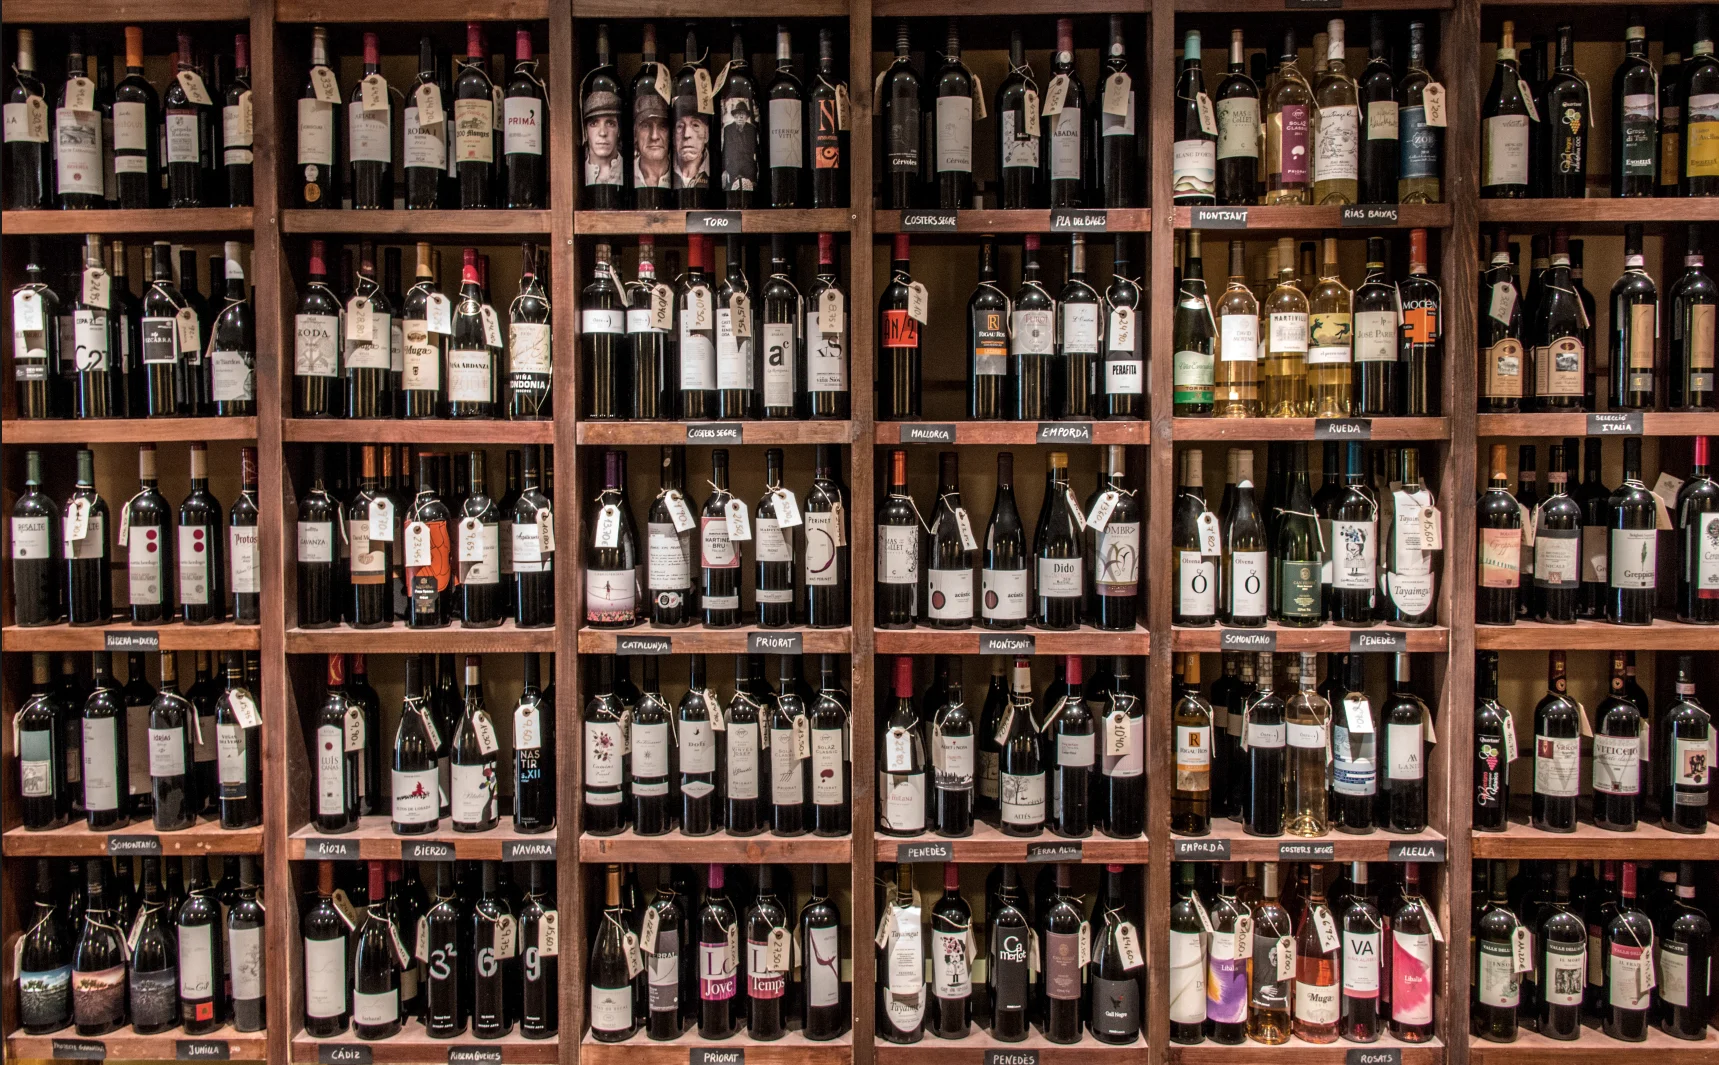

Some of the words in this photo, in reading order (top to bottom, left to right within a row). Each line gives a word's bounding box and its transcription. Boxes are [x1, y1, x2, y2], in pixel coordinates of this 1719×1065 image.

[818, 100, 836, 134] N
[772, 128, 800, 136] ETERNUM
[1053, 130, 1079, 138] ABADAL
[893, 158, 918, 166] Cérvoles
[946, 157, 970, 165] Cérvoles
[703, 217, 729, 226] TORO
[905, 215, 937, 226] COSTERS
[938, 215, 957, 226] SEGRE
[1055, 216, 1071, 227] PLA
[1084, 215, 1106, 226] BAGES
[1199, 211, 1248, 222] MONTSANT
[405, 344, 432, 356] Muga
[463, 362, 490, 370] ARDANZA
[1112, 364, 1137, 375] PERAFITA
[688, 428, 716, 439] COSTERS
[716, 428, 737, 438] SEGRE
[1328, 423, 1361, 434] RUEDA
[911, 429, 949, 440] MALLORCA
[18, 522, 46, 533] RESALTE
[235, 533, 258, 546] Protos
[1053, 563, 1075, 573] Dido
[107, 635, 132, 646] RIBERA
[139, 636, 159, 646] DUERO
[756, 637, 796, 648] PRIORAT
[1360, 631, 1396, 645] PENEDÈS
[621, 641, 669, 653] CATALUNYA
[989, 638, 1031, 650] MONTSANT
[1188, 732, 1200, 747] R
[520, 749, 541, 759] NAS
[520, 760, 537, 769] TIR
[319, 842, 347, 854] RIOJA
[413, 844, 447, 856] BIERZO
[512, 844, 552, 856] NAVARRA
[908, 844, 947, 857] PENEDÈS
[1031, 846, 1056, 855] TERRA
[1280, 846, 1311, 855] COSTERS
[1399, 846, 1435, 857] ALELLA
[1351, 939, 1375, 956] VA
[477, 946, 498, 978] 6
[525, 946, 542, 981] 9
[704, 980, 733, 997] Jove
[752, 975, 786, 994] Temps
[1308, 992, 1335, 1004] Muga
[331, 1048, 360, 1060] CÁDIZ
[703, 1052, 740, 1063] PRIORAT
[992, 1052, 1035, 1064] PENEDÈS
[1360, 1054, 1393, 1064] ROSATS
